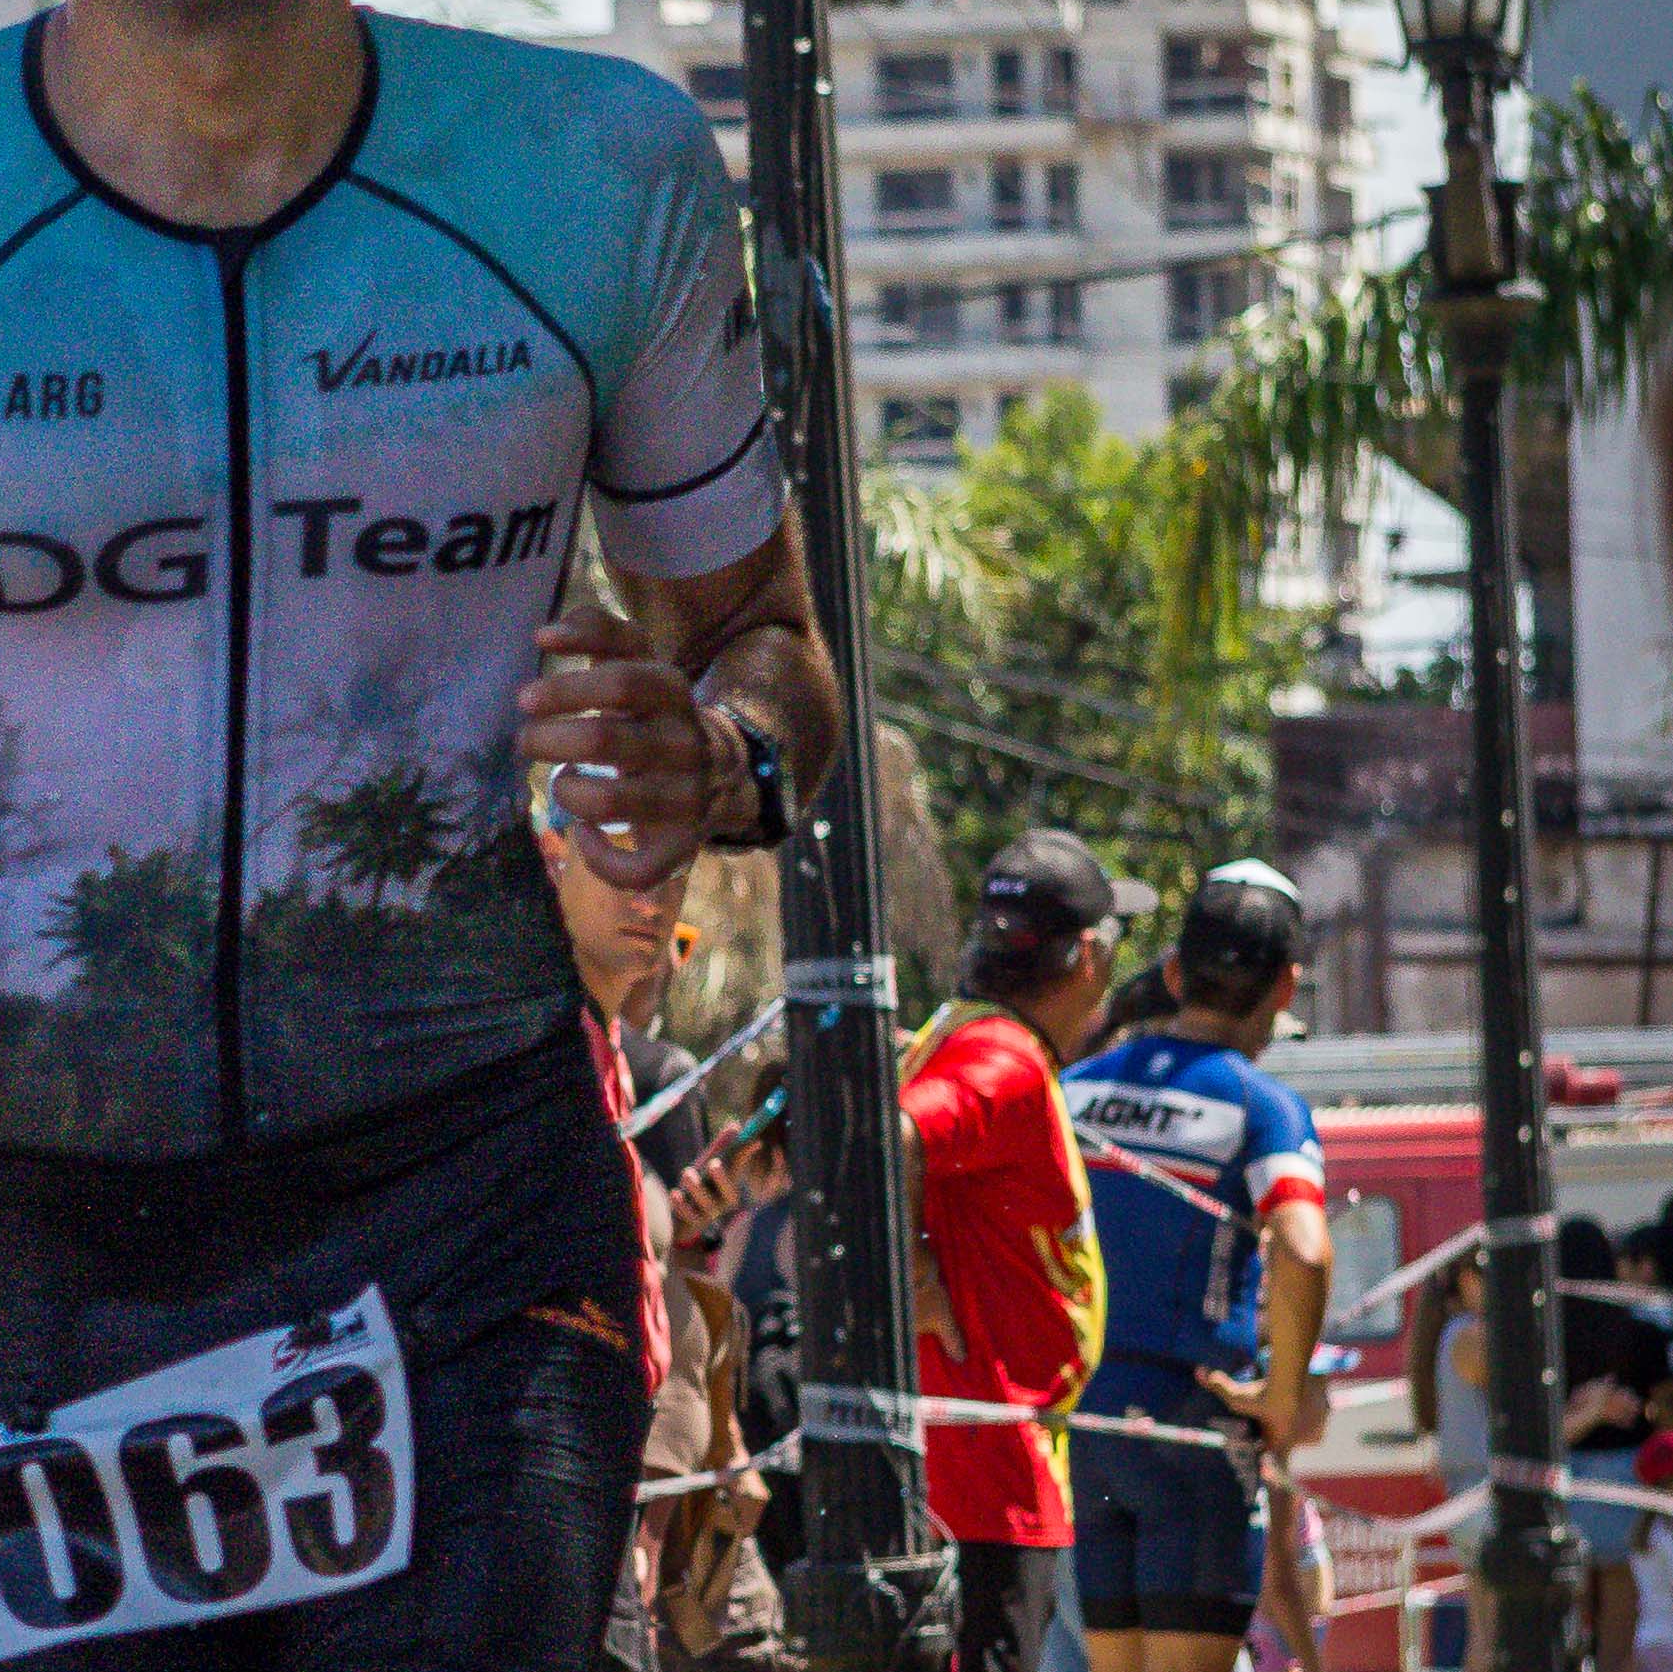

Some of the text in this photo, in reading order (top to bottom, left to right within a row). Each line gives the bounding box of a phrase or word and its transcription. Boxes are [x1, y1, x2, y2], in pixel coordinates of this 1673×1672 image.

[302, 330, 531, 394] VANDALIA
[4, 370, 105, 421] ARG
[273, 497, 559, 579] Team
